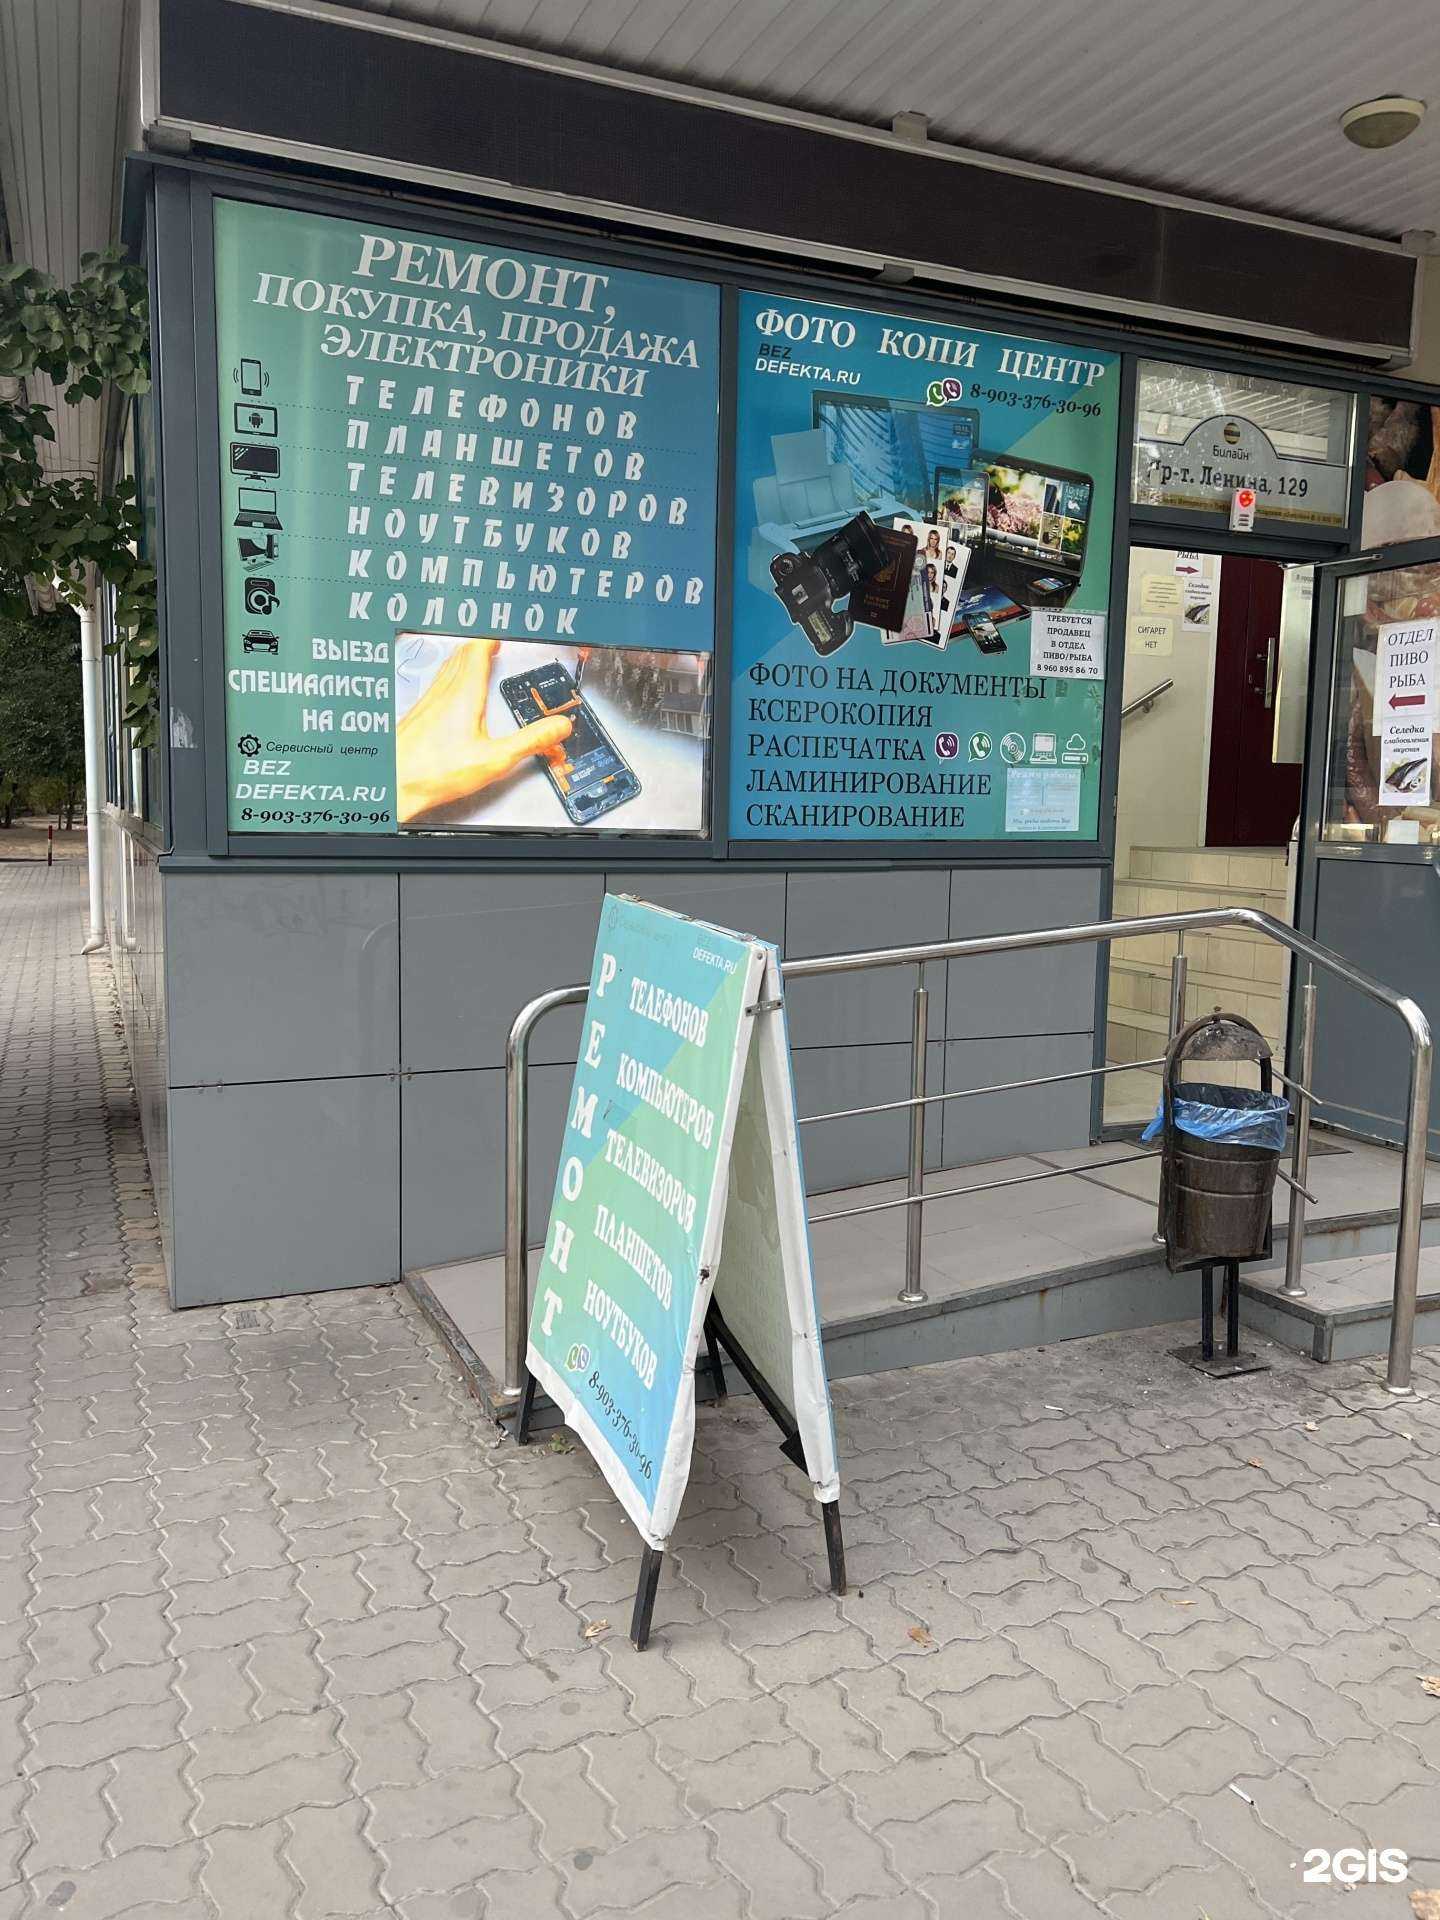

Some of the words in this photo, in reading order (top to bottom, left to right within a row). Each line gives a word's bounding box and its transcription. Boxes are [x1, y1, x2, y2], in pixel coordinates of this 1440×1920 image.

[352, 234, 616, 322] РЕМОНТ,
[253, 272, 487, 344] ПОКУПКА,
[497, 311, 700, 368] ПРОДАЖА
[320, 324, 649, 398] ЭЛЕКТРОНИКИ
[754, 308, 857, 348] ФОТО
[877, 328, 979, 369] КОПИ
[997, 348, 1105, 388] ЦЕНТР
[758, 343, 792, 361] BEZ
[754, 358, 861, 386] DEFEKTA.RU
[345, 374, 637, 440] ТЕЛЕФОНОВ
[969, 383, 1102, 418] 8-903-376-30-96
[346, 419, 645, 481] ПЛАНШЕТОВ
[1213, 445, 1249, 461] Билайн
[347, 462, 689, 525] ТЕЛЕВИЗОРОВ
[1200, 466, 1272, 496] Ленина,
[1279, 477, 1308, 498] 129
[347, 506, 632, 560] НОУТБУКОВ
[348, 549, 704, 606] КОМПЬЮТЕРОВ
[349, 592, 578, 634] КОЛОНОК
[1047, 614, 1093, 625] ТРЕБУЕТСЯ
[1047, 627, 1091, 638] ПРОДАВЕЦ
[1137, 626, 1167, 635] СИГАРЕТ
[1388, 628, 1434, 646] ОТДЕЛ
[312, 638, 389, 663] ВЫЕЗД
[1043, 651, 1093, 662] ПИВО/РЫБА
[1051, 641, 1057, 649] В
[1058, 641, 1086, 650] ОТДЕЛ
[1144, 641, 1158, 649] НЕТ
[1389, 650, 1429, 668] ПИВО
[749, 662, 829, 690] ФОТО
[836, 667, 873, 692] НА
[880, 669, 1048, 700] ДОКУМЕНТЫ
[1043, 664, 1058, 673] 960
[1059, 665, 1074, 673] 895
[1075, 666, 1086, 675] 86
[1088, 667, 1099, 675] 70
[1389, 673, 1426, 689] РЫБА
[228, 669, 389, 700] СПЕЦИАЛИСТА
[302, 709, 333, 733] НА
[341, 711, 389, 733] ДОМ
[748, 698, 933, 728] КСЕРОКОПИЯ
[1389, 724, 1425, 735] Селедка
[266, 741, 333, 755] Сервисный
[340, 746, 378, 758] центр
[748, 733, 926, 762] РАСПЕЧАТКА
[243, 759, 291, 776] BEZ
[235, 783, 386, 802] DEFEKTA.RU
[745, 768, 992, 796] ЛАМИНИРОВАНИЕ
[241, 808, 390, 825] 8-903-376-30-96
[746, 804, 965, 828] СКАНИРОВАНИЕ
[693, 947, 737, 975] DEFEKTA.RU
[628, 976, 710, 1048] ТЕЛЕФОНОВ
[616, 1052, 715, 1150] КОМПЬЮТЕРОВ
[604, 1129, 697, 1234] ТЕЛЕВИЗОРОВ
[594, 1204, 673, 1311] ПЛАНШЕТОВ
[582, 1278, 657, 1391] НОУТБУКОВ
[588, 1371, 652, 1480] 8-903-376-30-96
